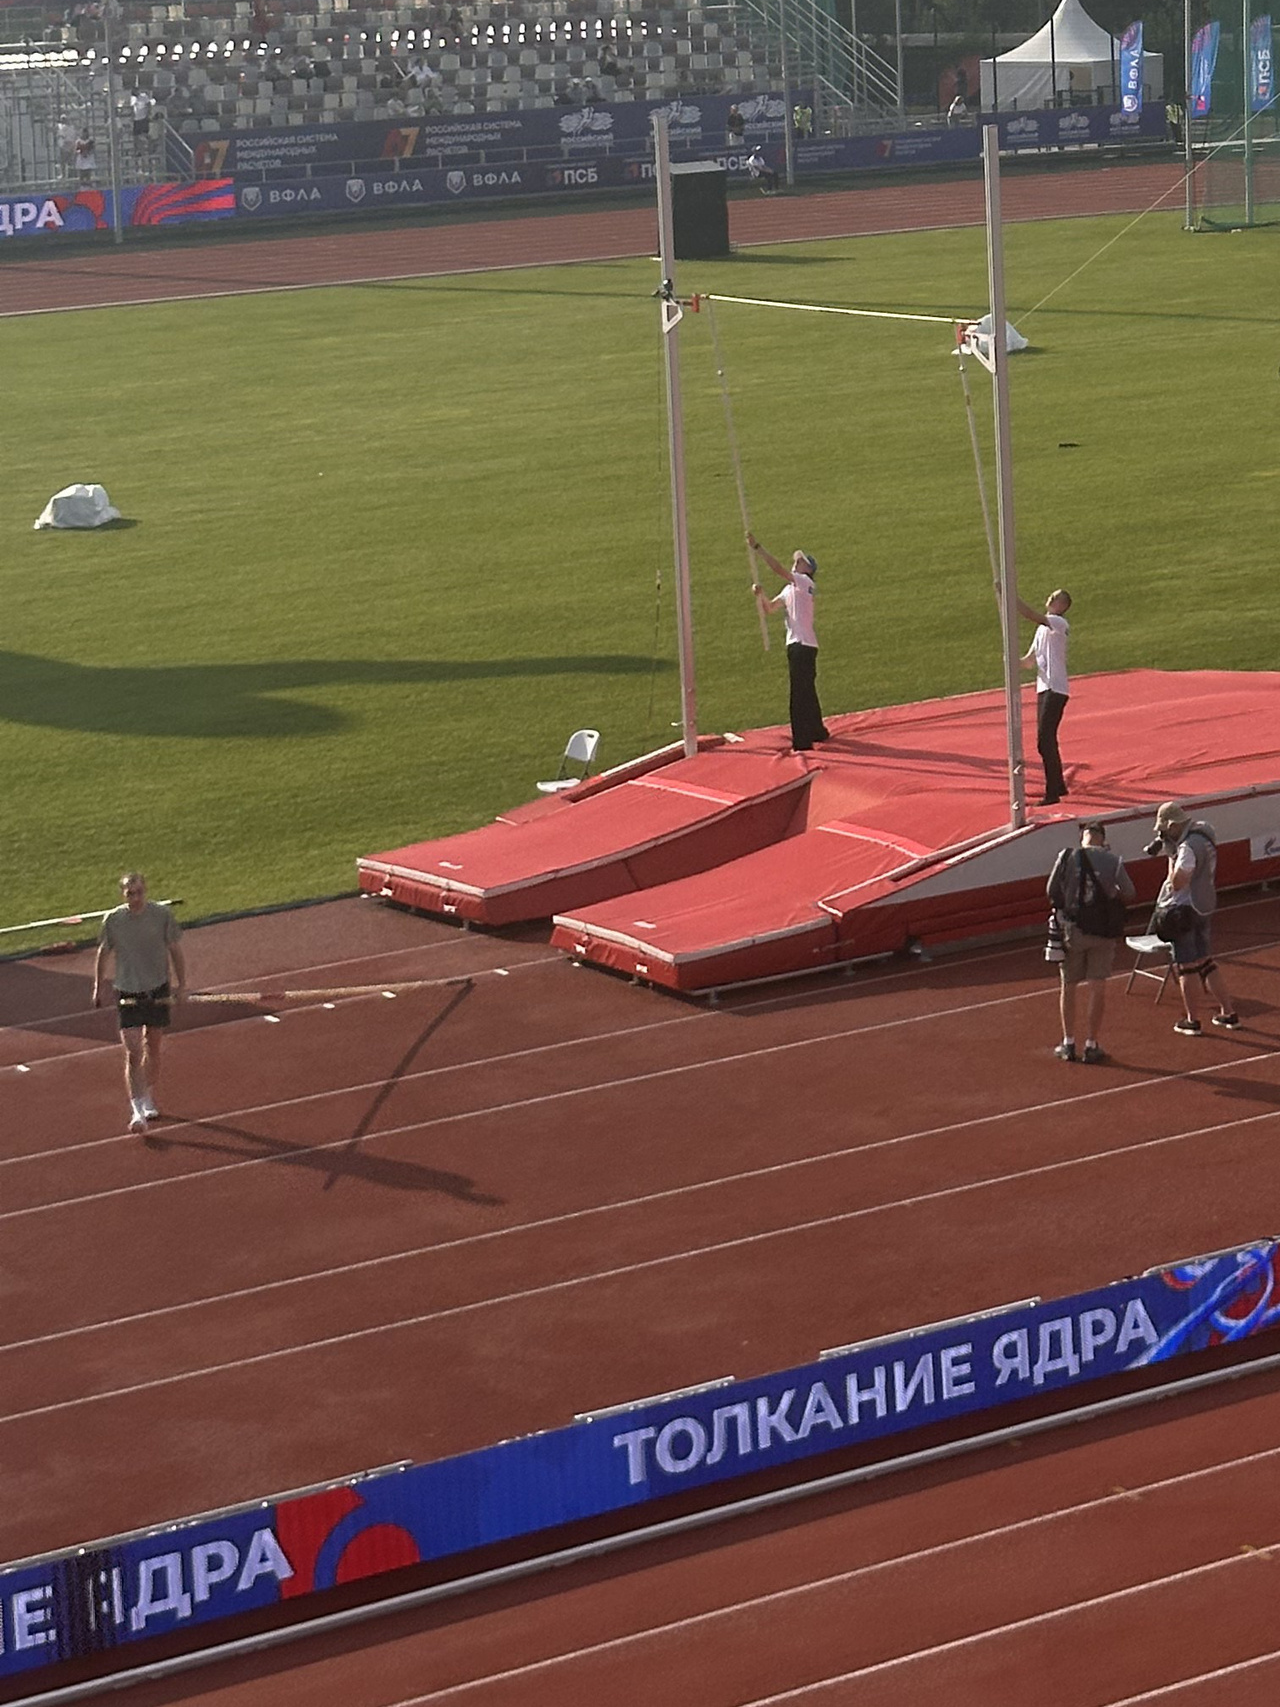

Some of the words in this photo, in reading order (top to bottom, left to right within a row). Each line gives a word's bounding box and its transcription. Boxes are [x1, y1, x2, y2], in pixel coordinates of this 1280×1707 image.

[1128, 49, 1140, 89] ВФЛА
[1258, 49, 1271, 83] ПСБ
[473, 170, 522, 186] ВФЛА
[564, 167, 598, 185] ПСБ
[270, 187, 322, 203] ВФЛА
[373, 178, 423, 194] ВФЛА
[613, 1342, 976, 1486] ТОЛКАНИЕ
[992, 1297, 1160, 1387] ЯДРА
